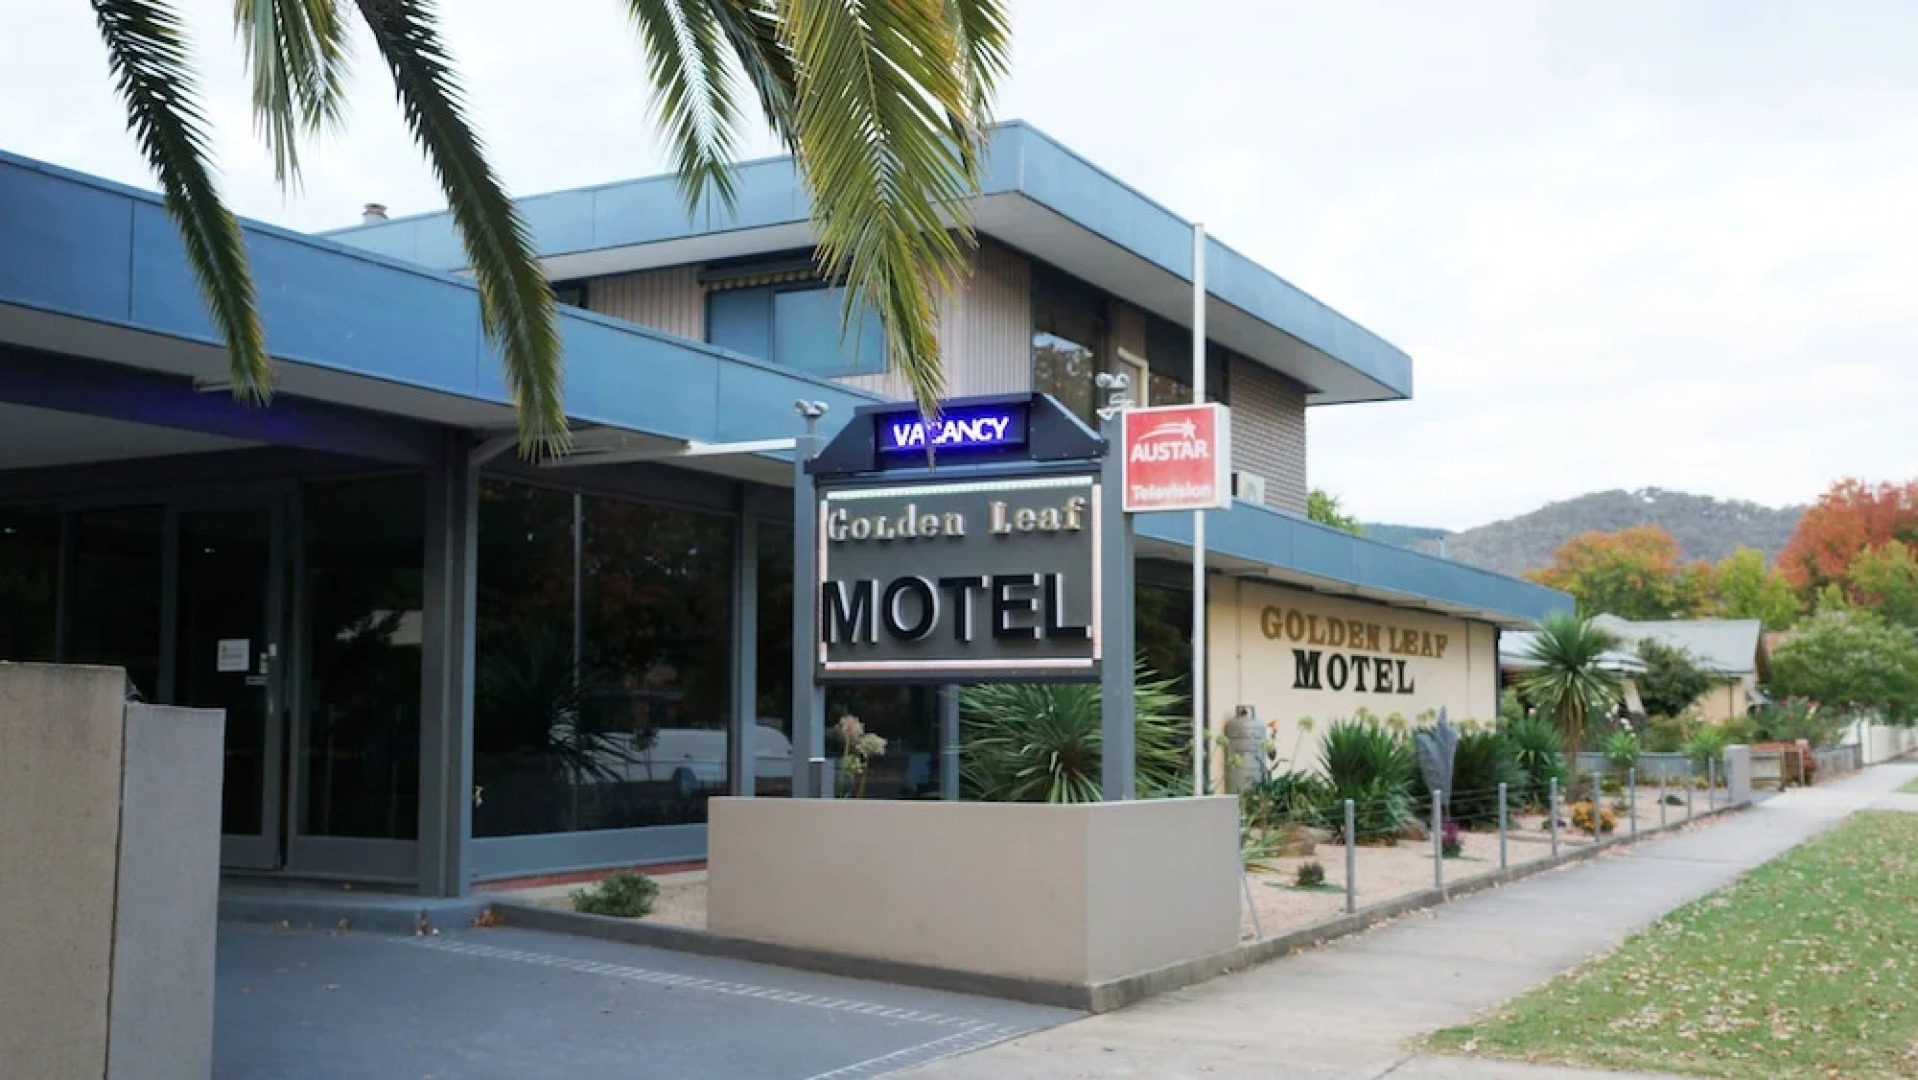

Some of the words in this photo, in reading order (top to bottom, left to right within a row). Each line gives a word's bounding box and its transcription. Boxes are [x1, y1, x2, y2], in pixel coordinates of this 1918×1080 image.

[1130, 438, 1210, 463] AUSTAR
[1131, 482, 1211, 501] Television
[989, 496, 1085, 534] Leaf
[822, 572, 1092, 644] MOTEL
[1260, 605, 1381, 651] GOLDEN
[1387, 627, 1448, 658] LEAF
[1292, 649, 1414, 694] MOTEL
